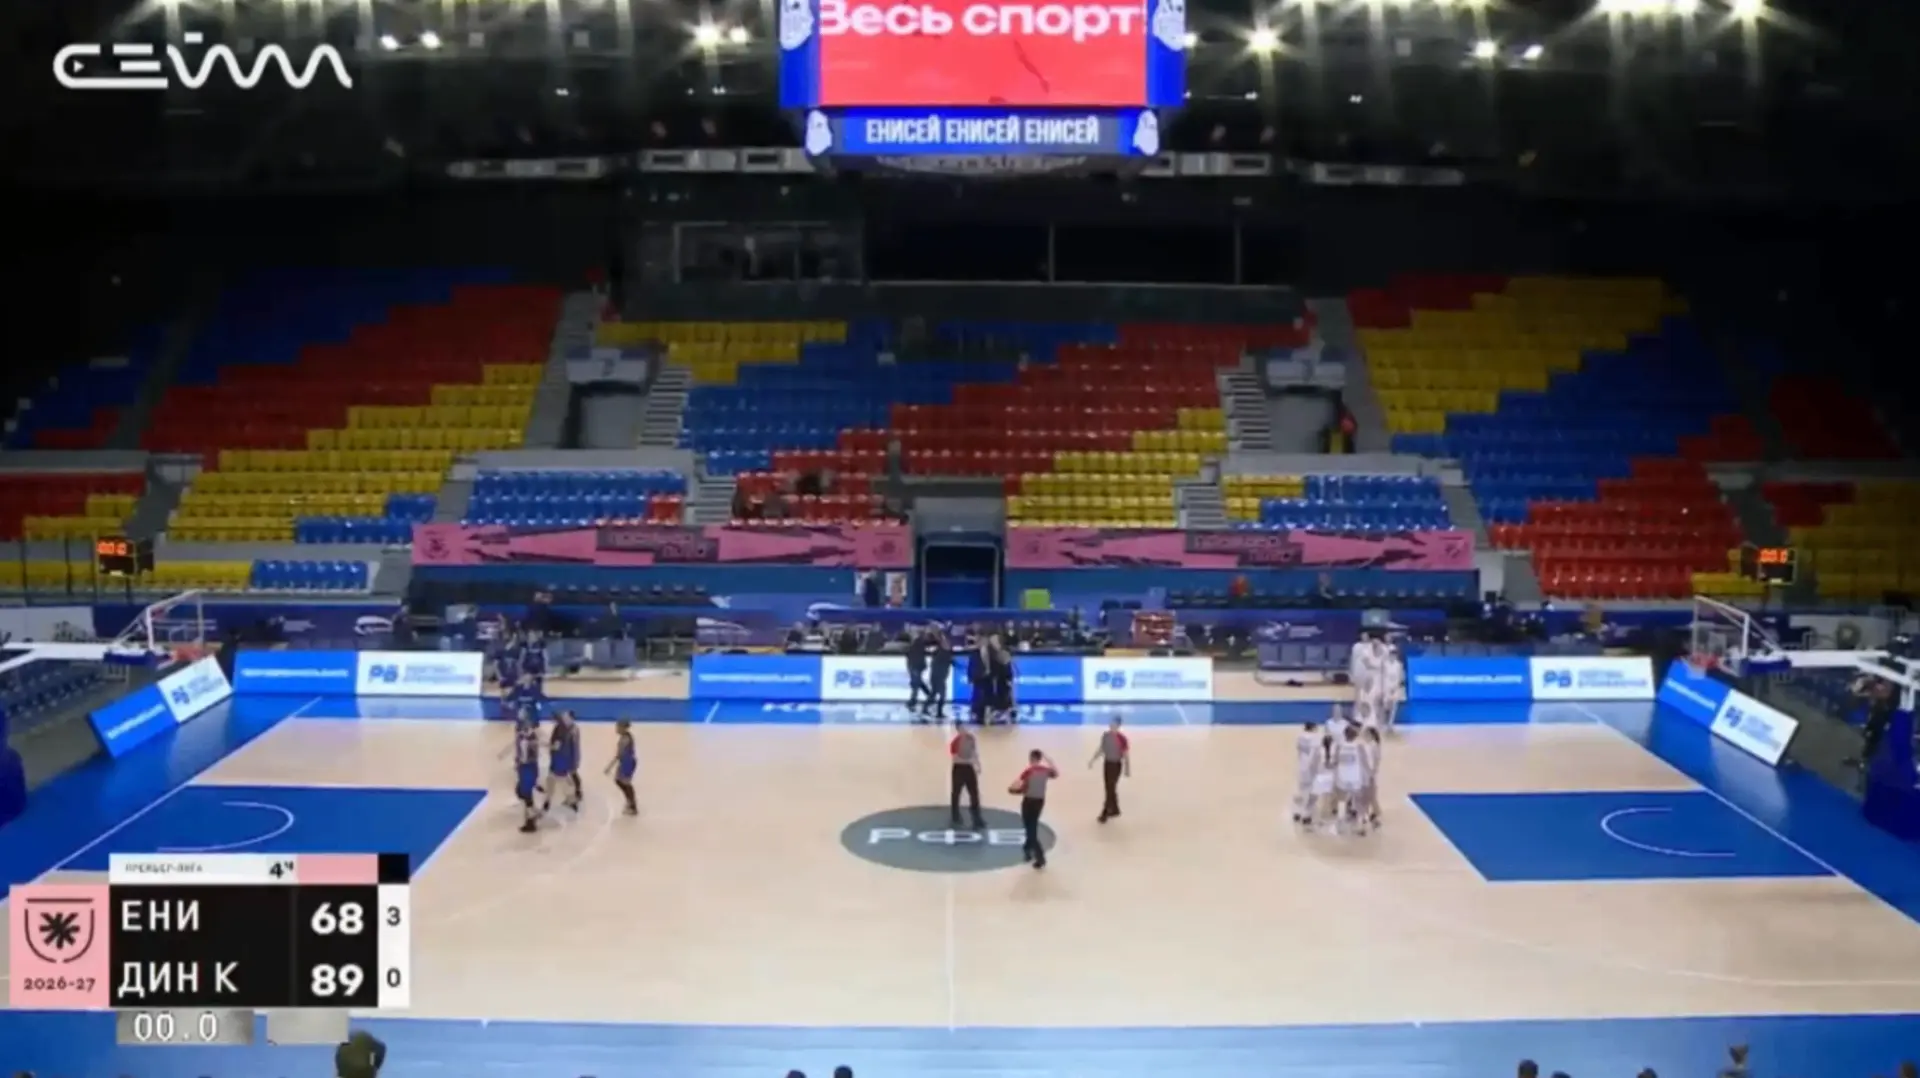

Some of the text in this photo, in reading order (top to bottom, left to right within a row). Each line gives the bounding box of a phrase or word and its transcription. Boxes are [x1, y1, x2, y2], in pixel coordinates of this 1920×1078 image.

[866, 114, 1100, 144] ЕНИСЕЙ ЕНИСЕЙ ЕНИСЕЙ
[867, 826, 1027, 846] РФБ
